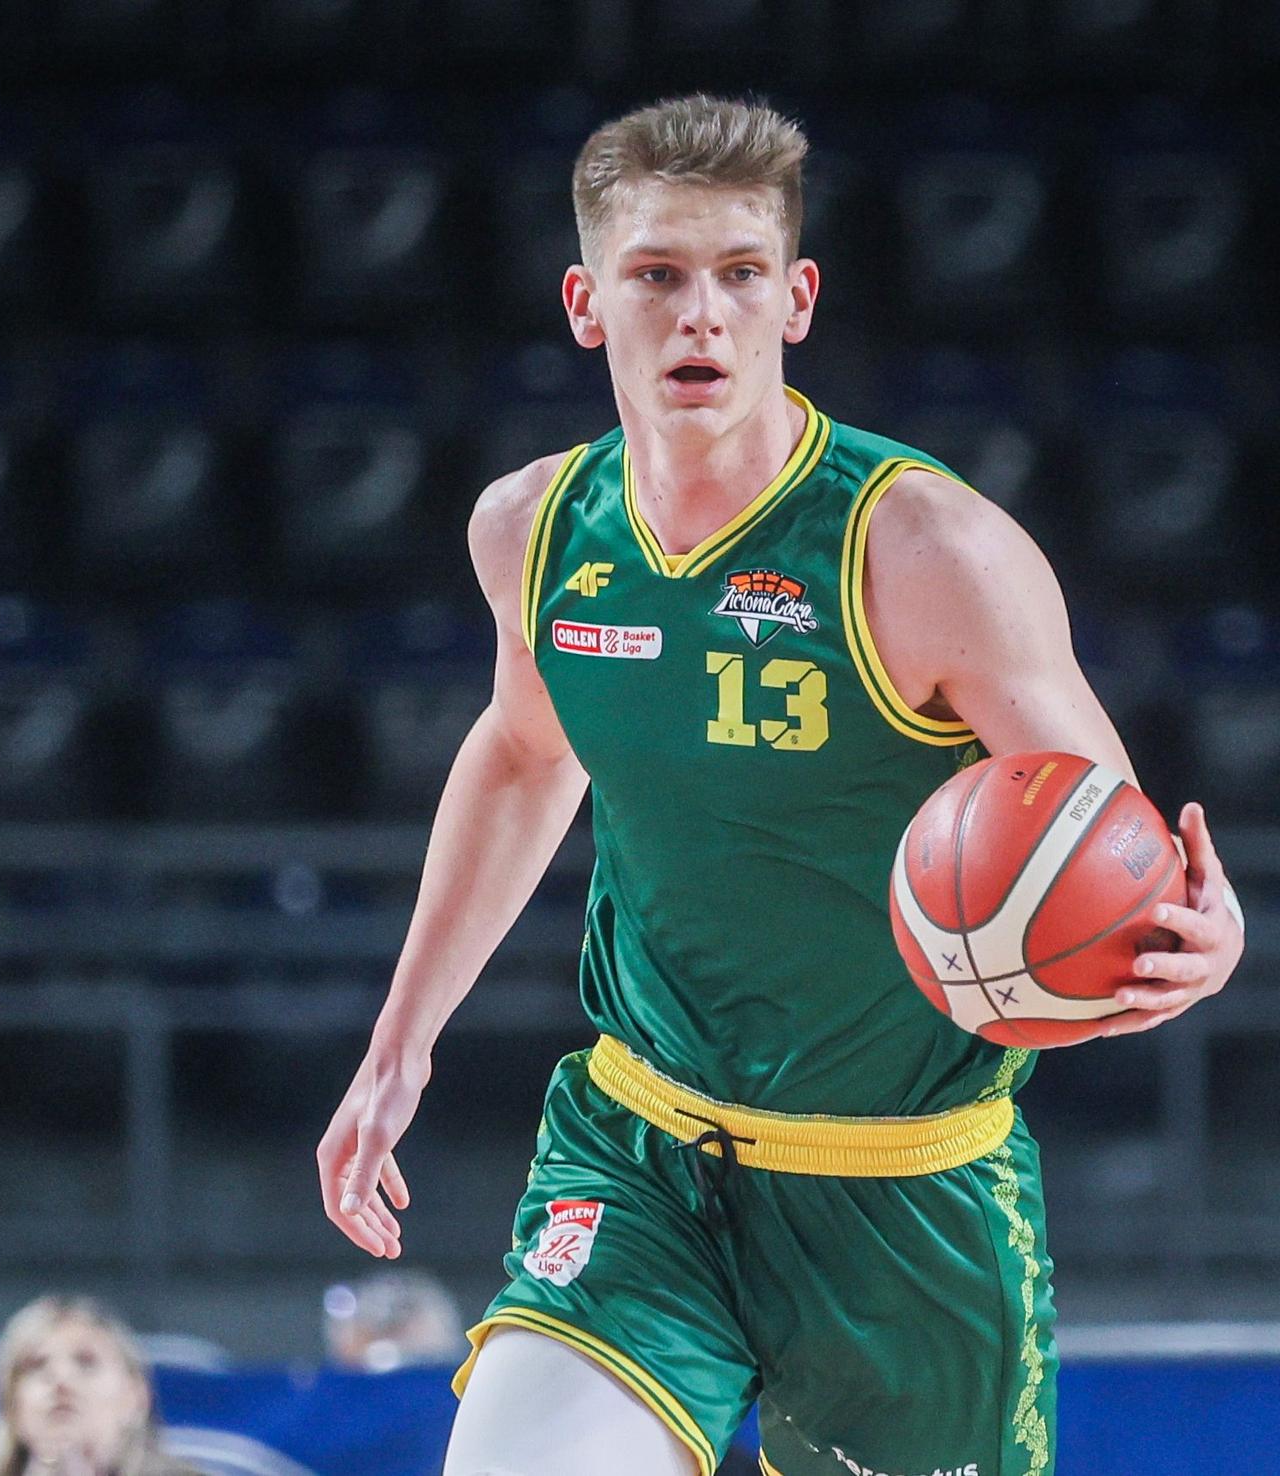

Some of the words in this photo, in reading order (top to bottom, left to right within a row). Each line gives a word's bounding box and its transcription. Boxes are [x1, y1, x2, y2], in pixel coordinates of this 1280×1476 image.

[565, 562, 614, 597] 4F
[557, 627, 597, 648] ORLEN
[623, 631, 655, 642] Basket
[623, 642, 641, 655] Liga
[706, 651, 829, 751] 13
[554, 1207, 595, 1223] ORLEN
[538, 1260, 563, 1275] Liga
